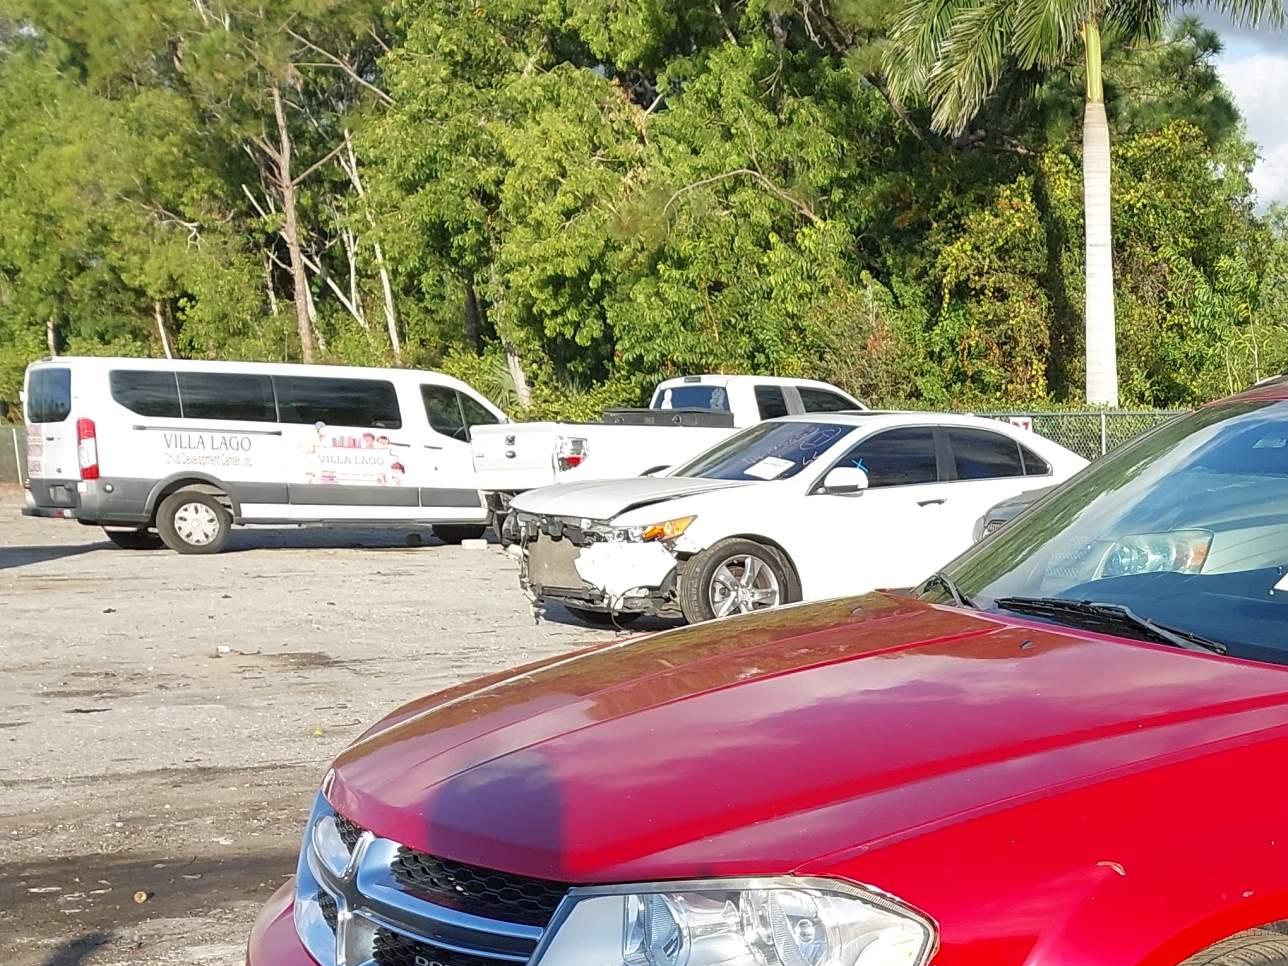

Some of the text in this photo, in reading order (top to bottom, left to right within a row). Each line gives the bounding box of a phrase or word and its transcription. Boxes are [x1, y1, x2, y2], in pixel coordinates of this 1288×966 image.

[163, 433, 252, 452] VILLA LAGO
[317, 454, 385, 466] VILLA LAGO
